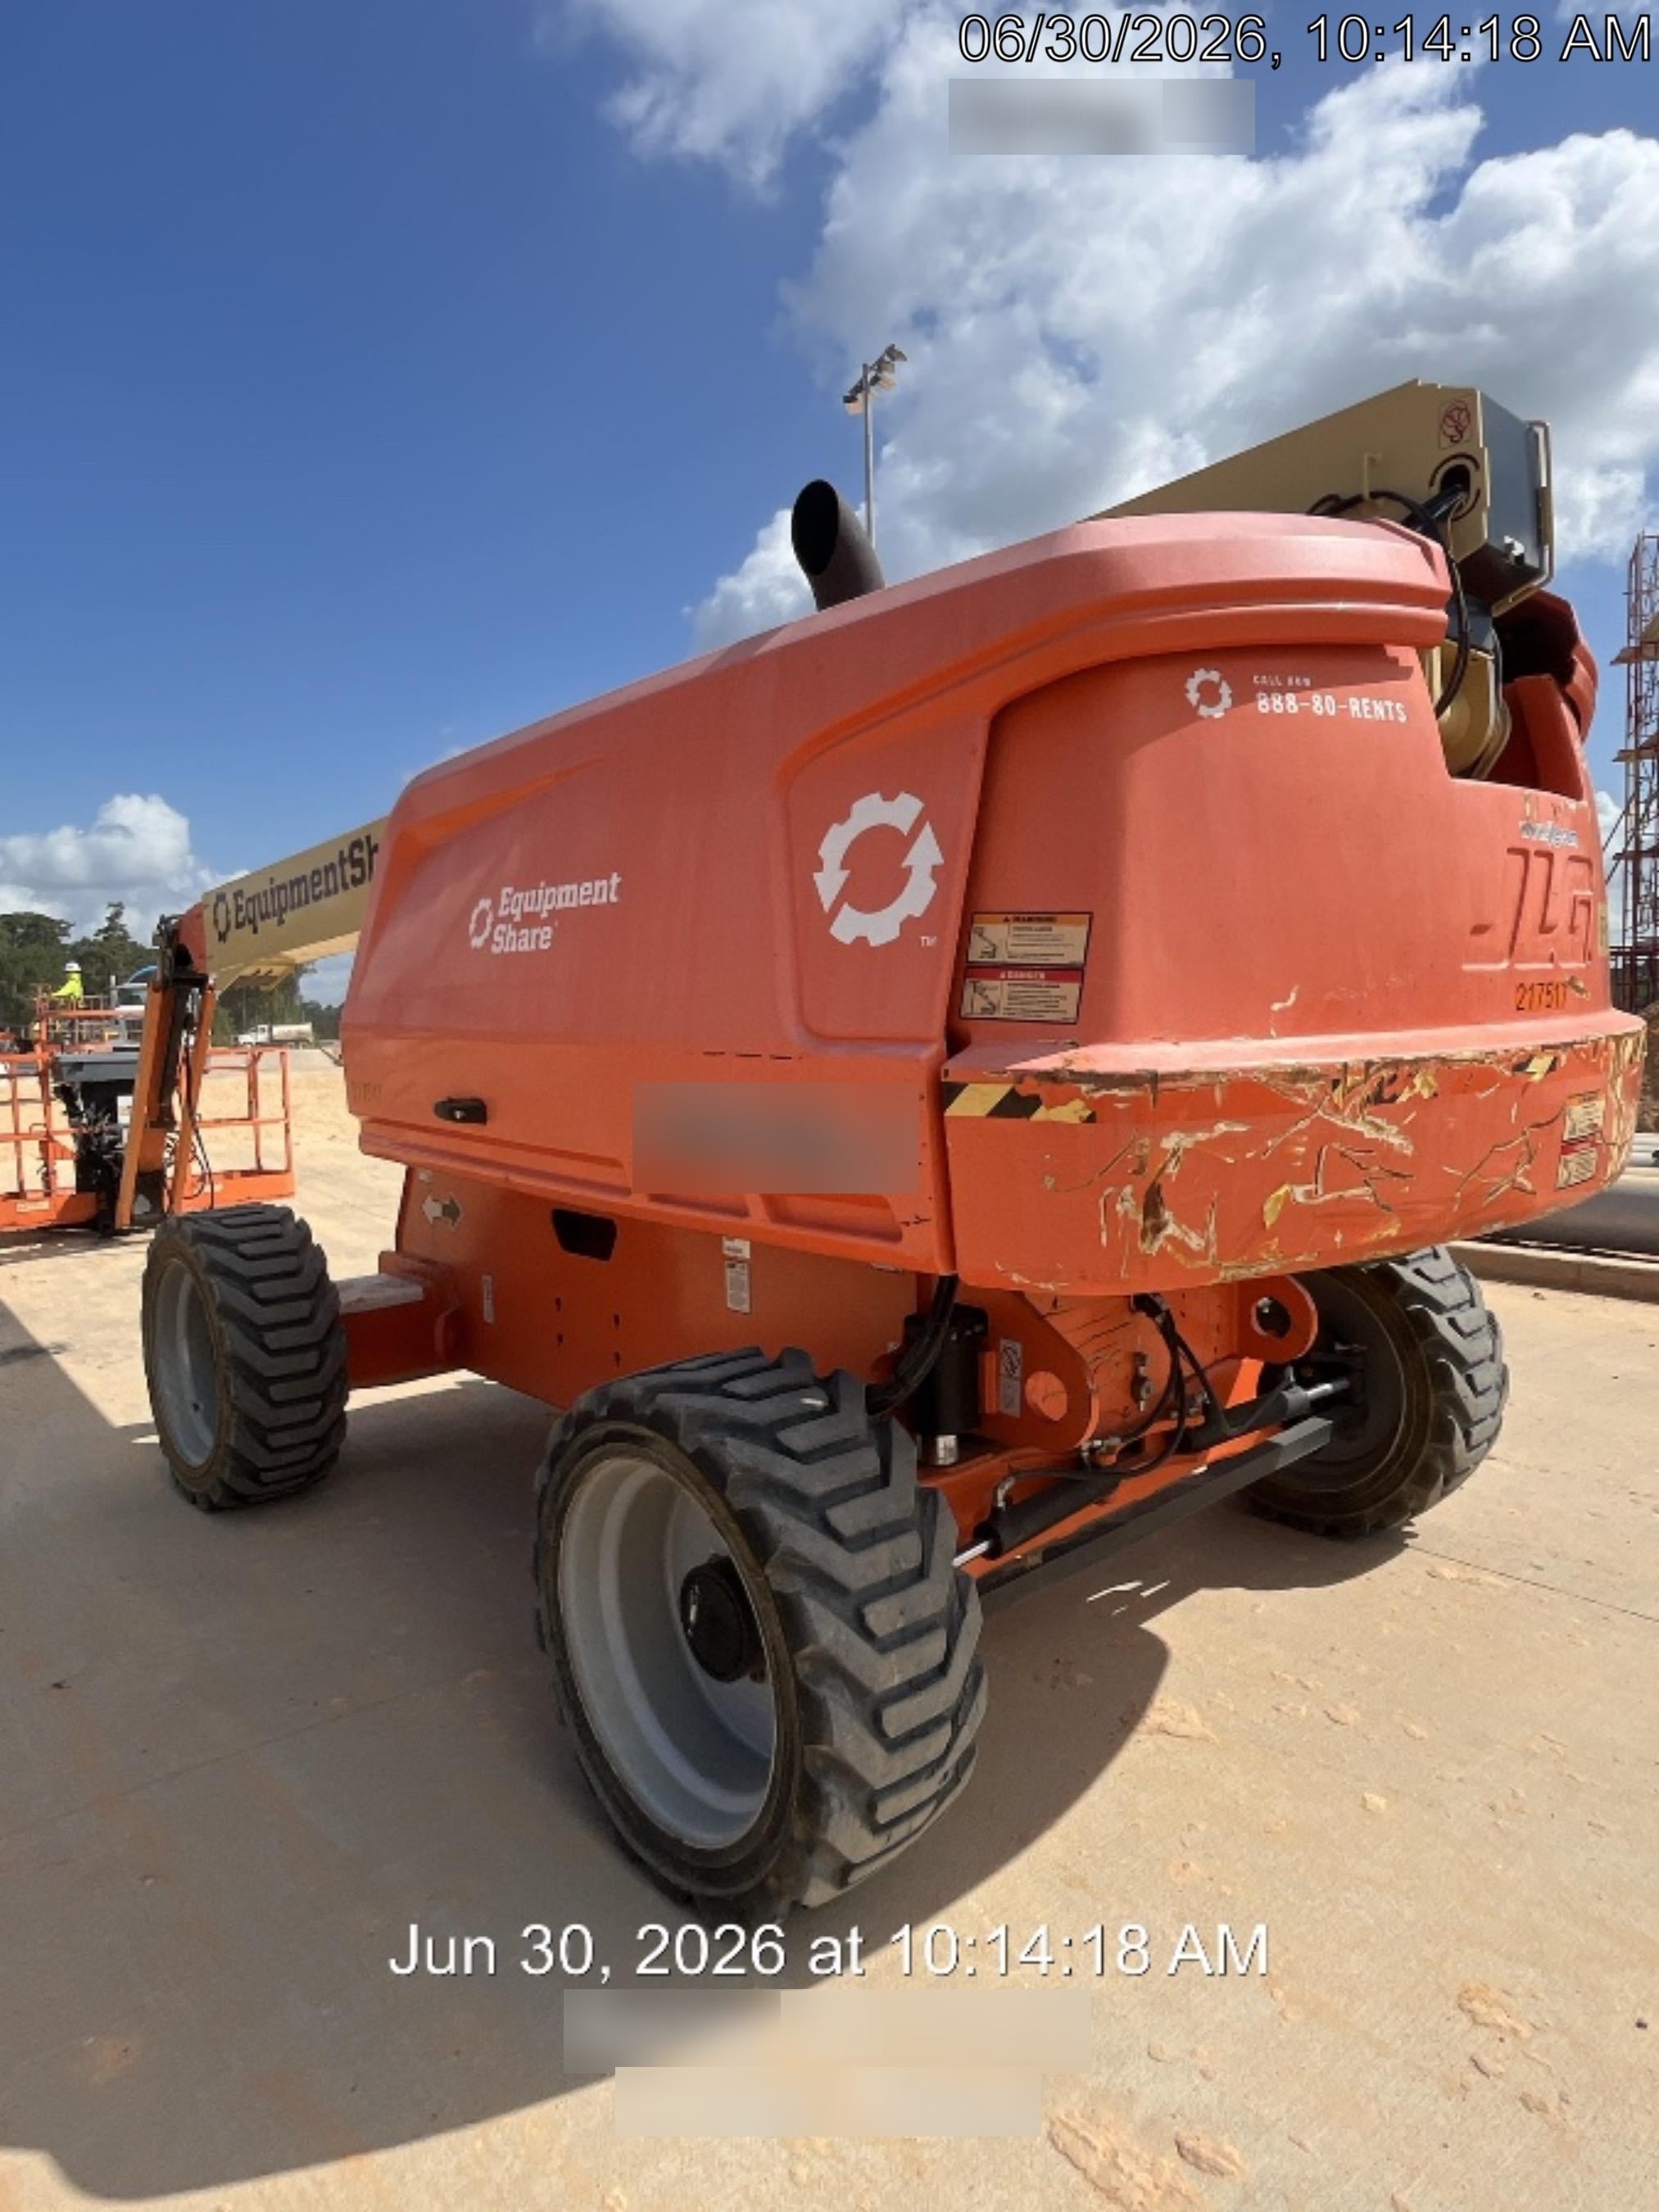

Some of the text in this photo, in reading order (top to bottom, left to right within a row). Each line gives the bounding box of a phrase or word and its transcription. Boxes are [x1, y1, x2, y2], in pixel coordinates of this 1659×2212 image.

[1256, 691, 1407, 723] 888-80-RENTS
[497, 871, 623, 922] Equipment
[491, 922, 553, 954] Share
